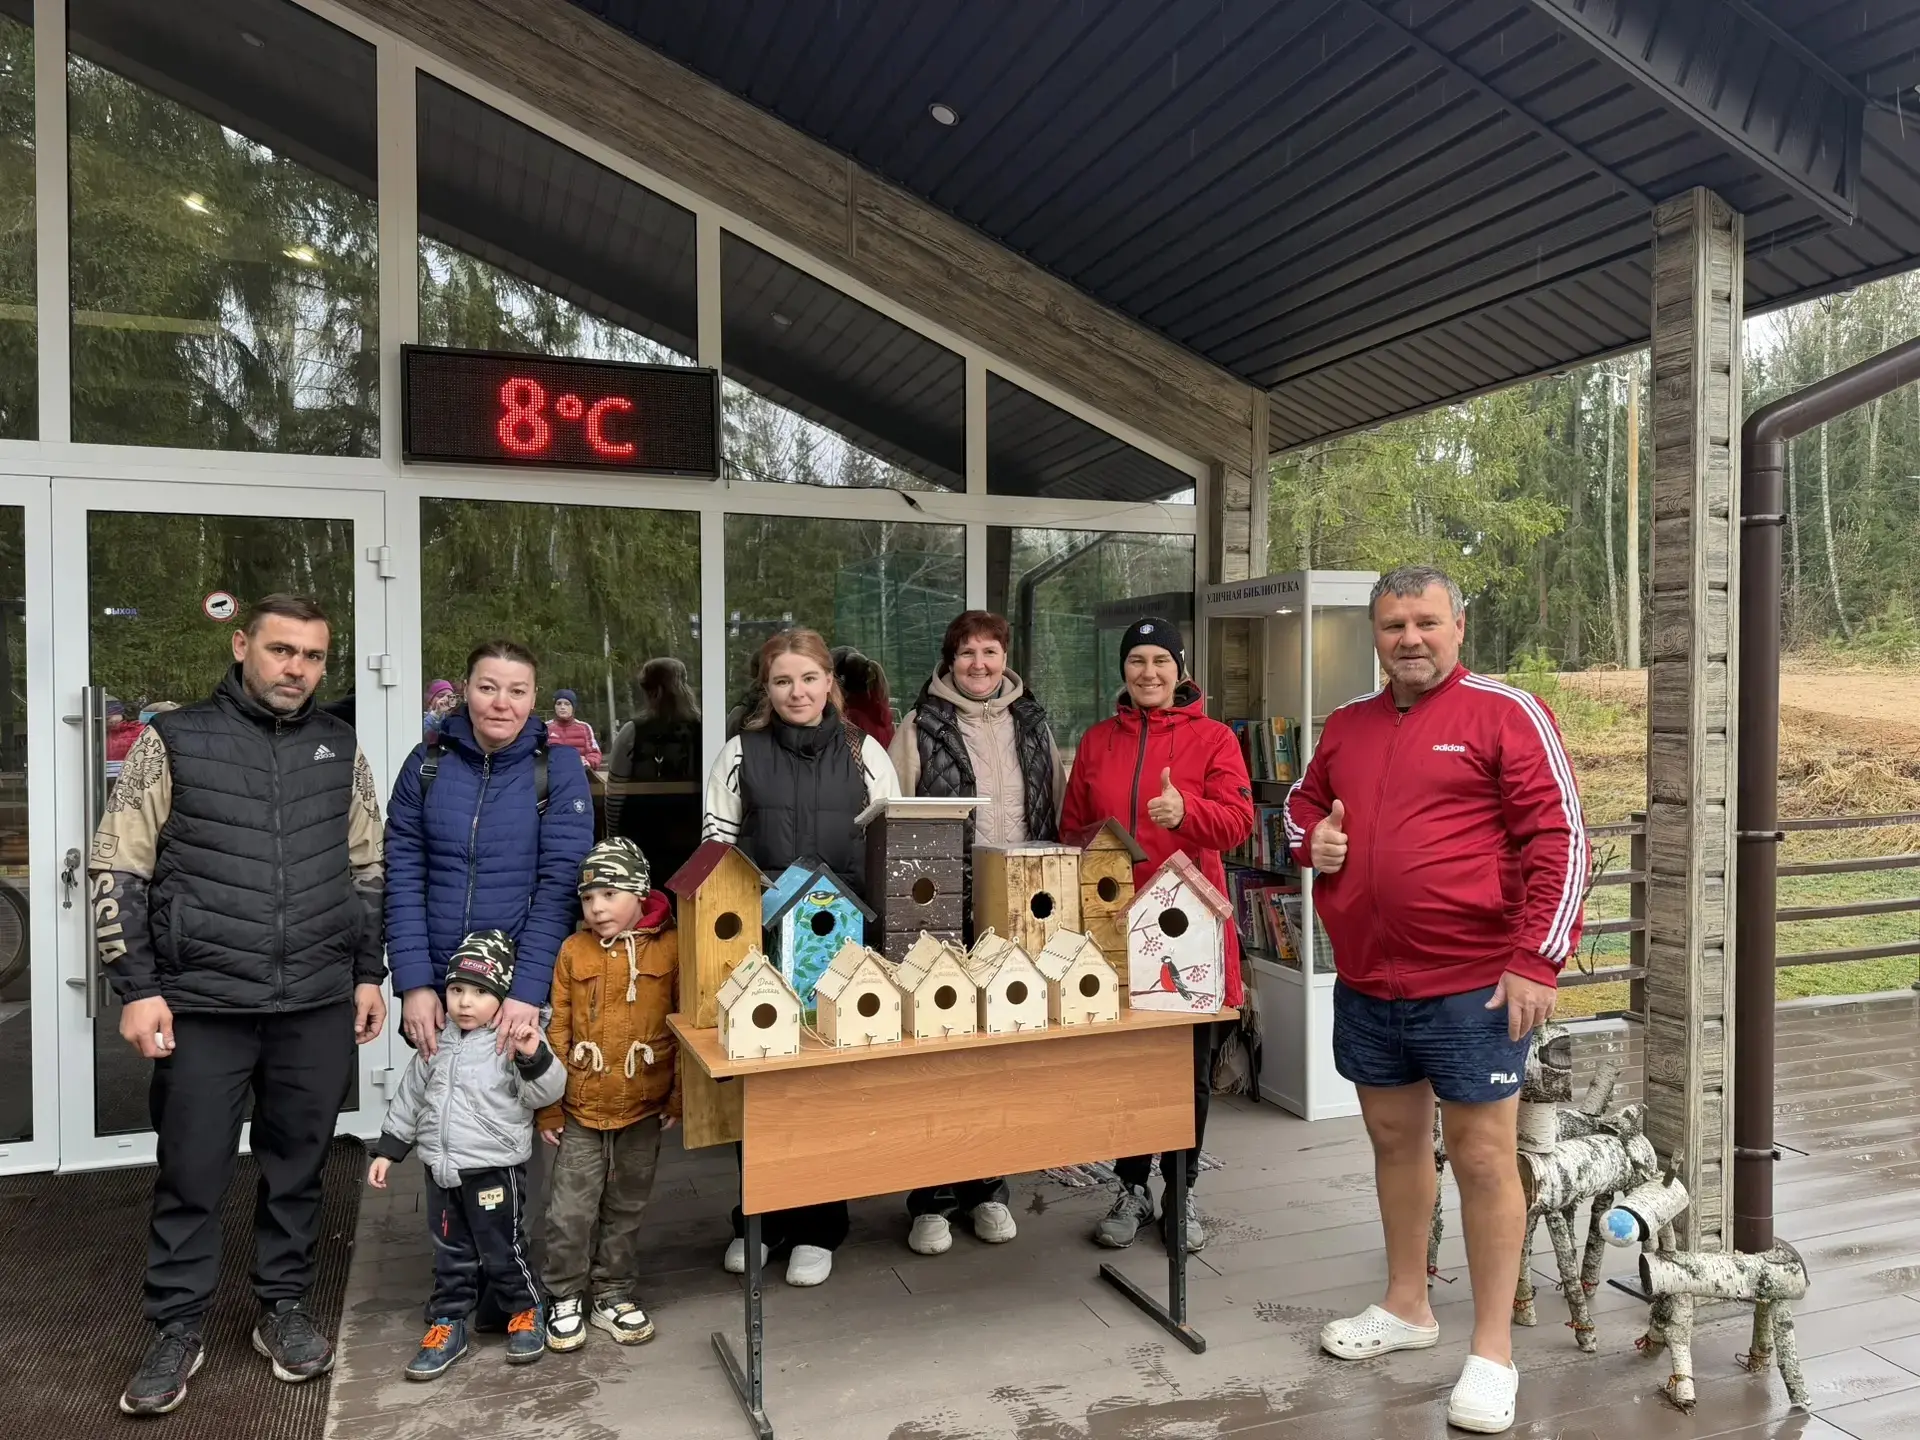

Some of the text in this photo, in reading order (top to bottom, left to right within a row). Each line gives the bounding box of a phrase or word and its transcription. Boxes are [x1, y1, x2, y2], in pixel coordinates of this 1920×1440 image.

[499, 378, 633, 454] 8°C
[1206, 580, 1300, 604] УЛИЧНАЯ БИБЛИОТЕКА
[1432, 743, 1466, 752] adidas
[1490, 1072, 1519, 1084] FILA
